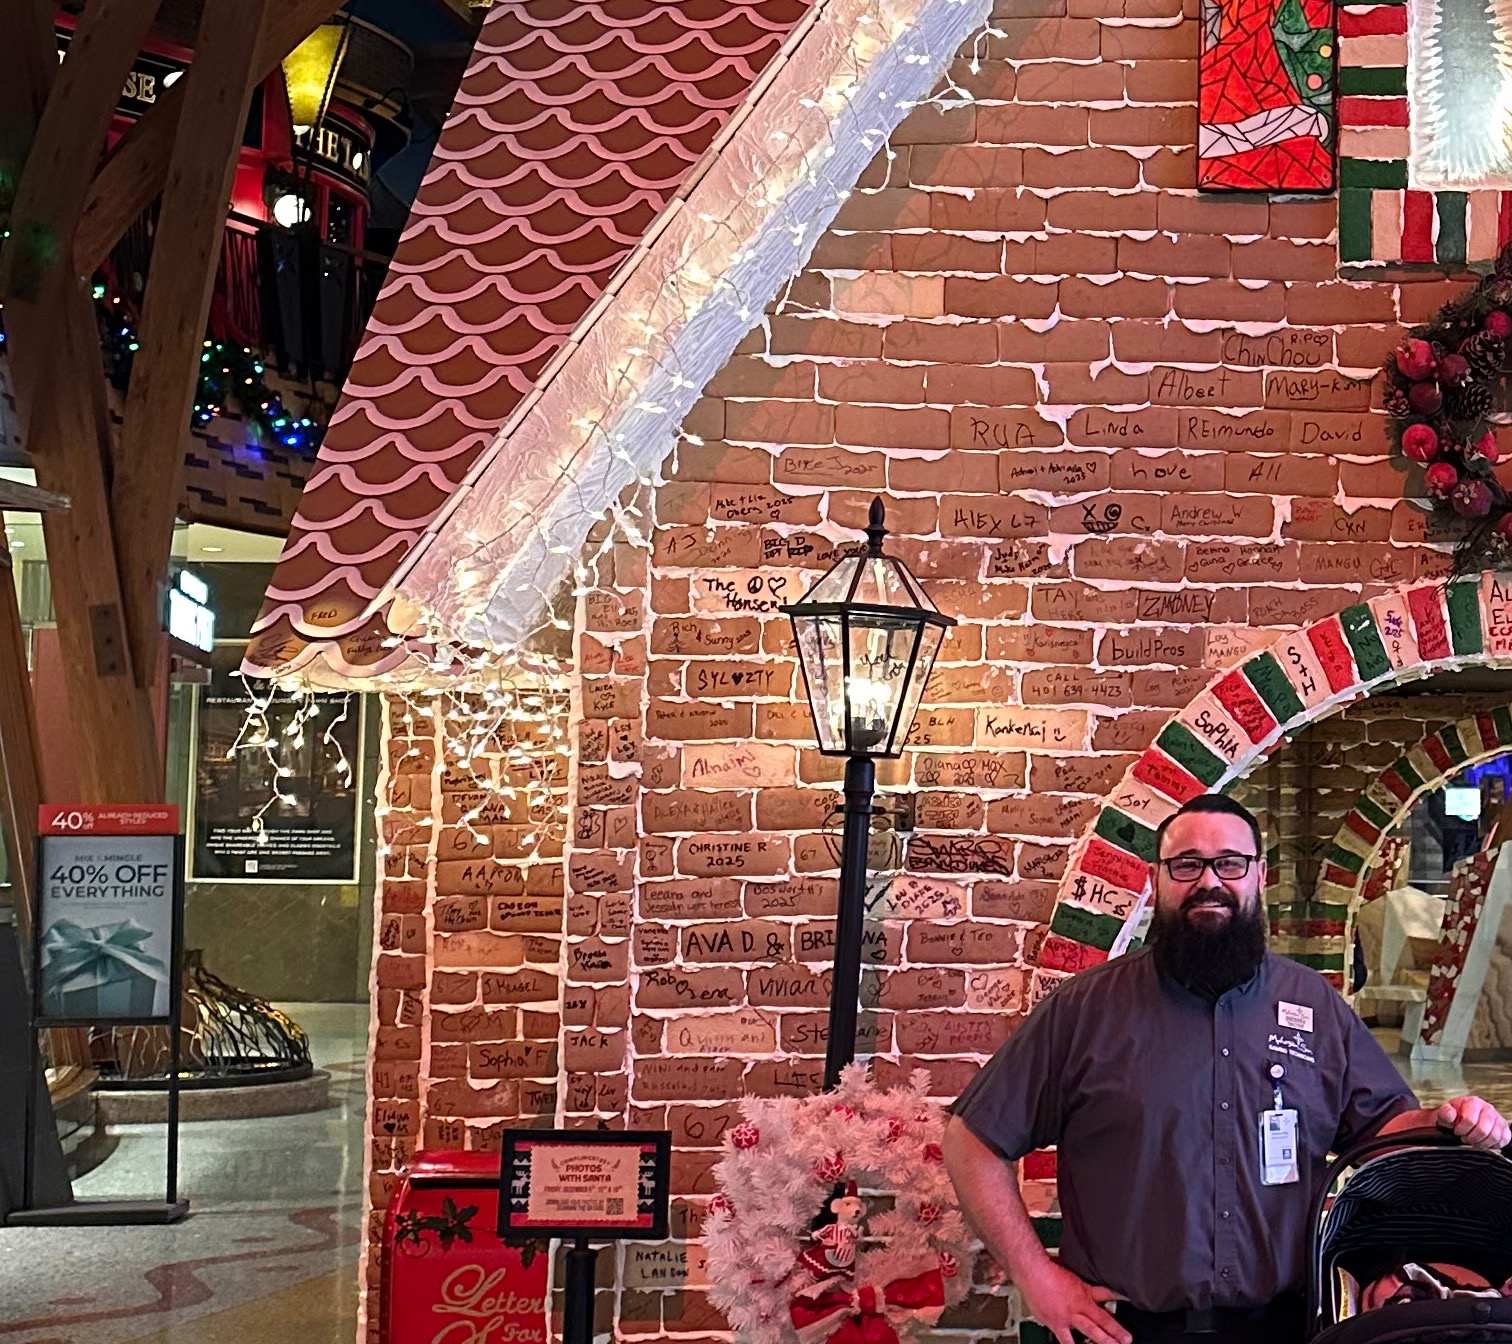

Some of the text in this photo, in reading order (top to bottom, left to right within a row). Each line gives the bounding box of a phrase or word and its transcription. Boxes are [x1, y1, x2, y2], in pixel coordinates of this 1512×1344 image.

[1301, 421, 1363, 444] David
[703, 578, 736, 592] The
[688, 842, 768, 854] CHRISTINE R
[706, 855, 745, 868] 2025
[50, 864, 168, 884] 40% OFF
[51, 886, 164, 898] EVERYTHING
[685, 929, 733, 957] AVA
[570, 1035, 608, 1047] JACK
[566, 1164, 602, 1173] PHOTOS
[559, 1174, 611, 1183] WITH SANTA
